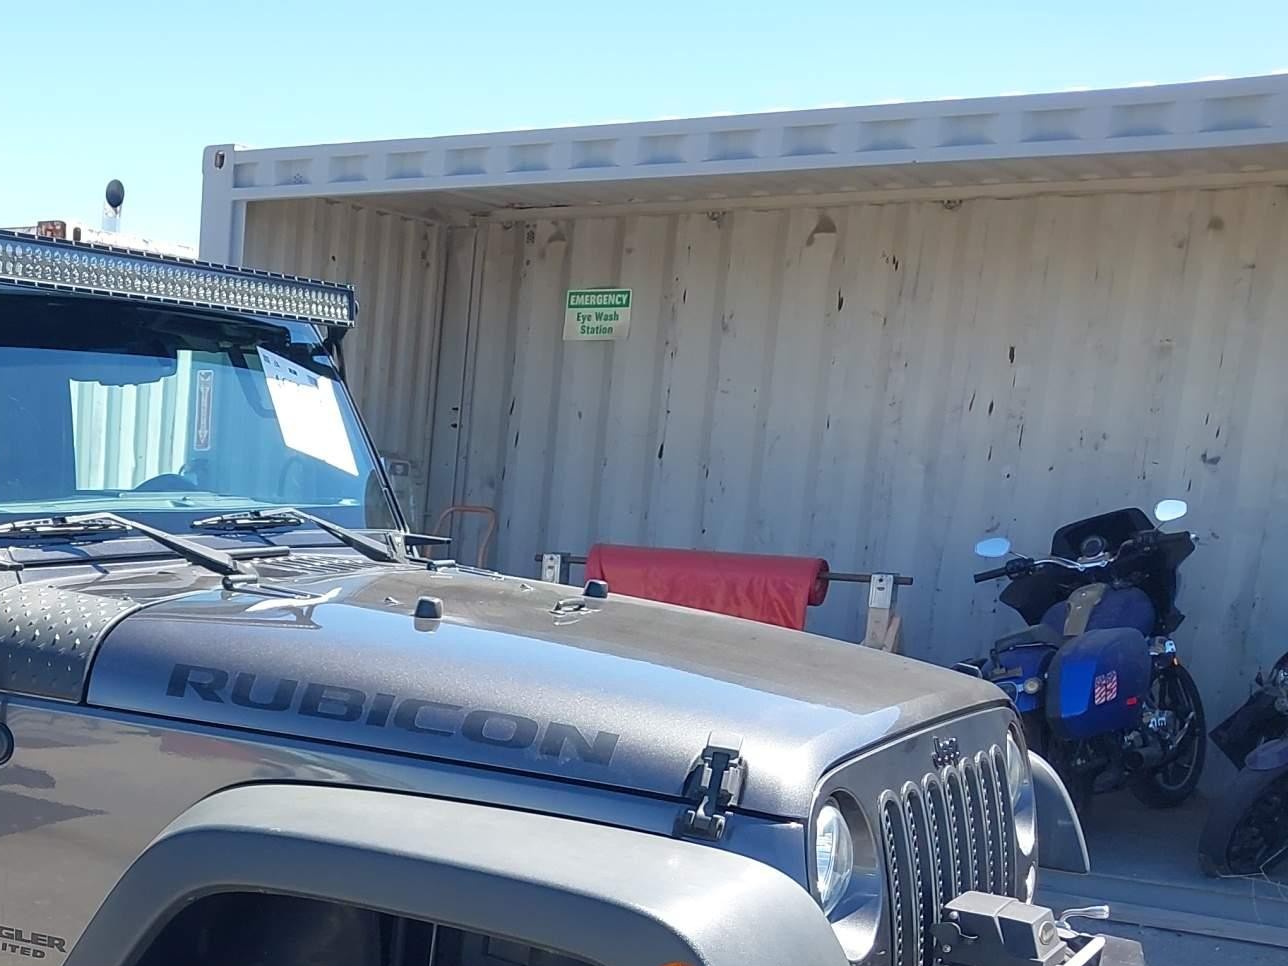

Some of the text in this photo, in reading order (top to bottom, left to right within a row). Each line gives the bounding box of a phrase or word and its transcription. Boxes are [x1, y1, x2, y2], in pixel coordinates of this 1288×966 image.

[570, 294, 628, 305] EMERGENCY
[576, 311, 619, 324] Eye Wash
[580, 325, 613, 335] Station
[165, 663, 620, 767] RUBICON
